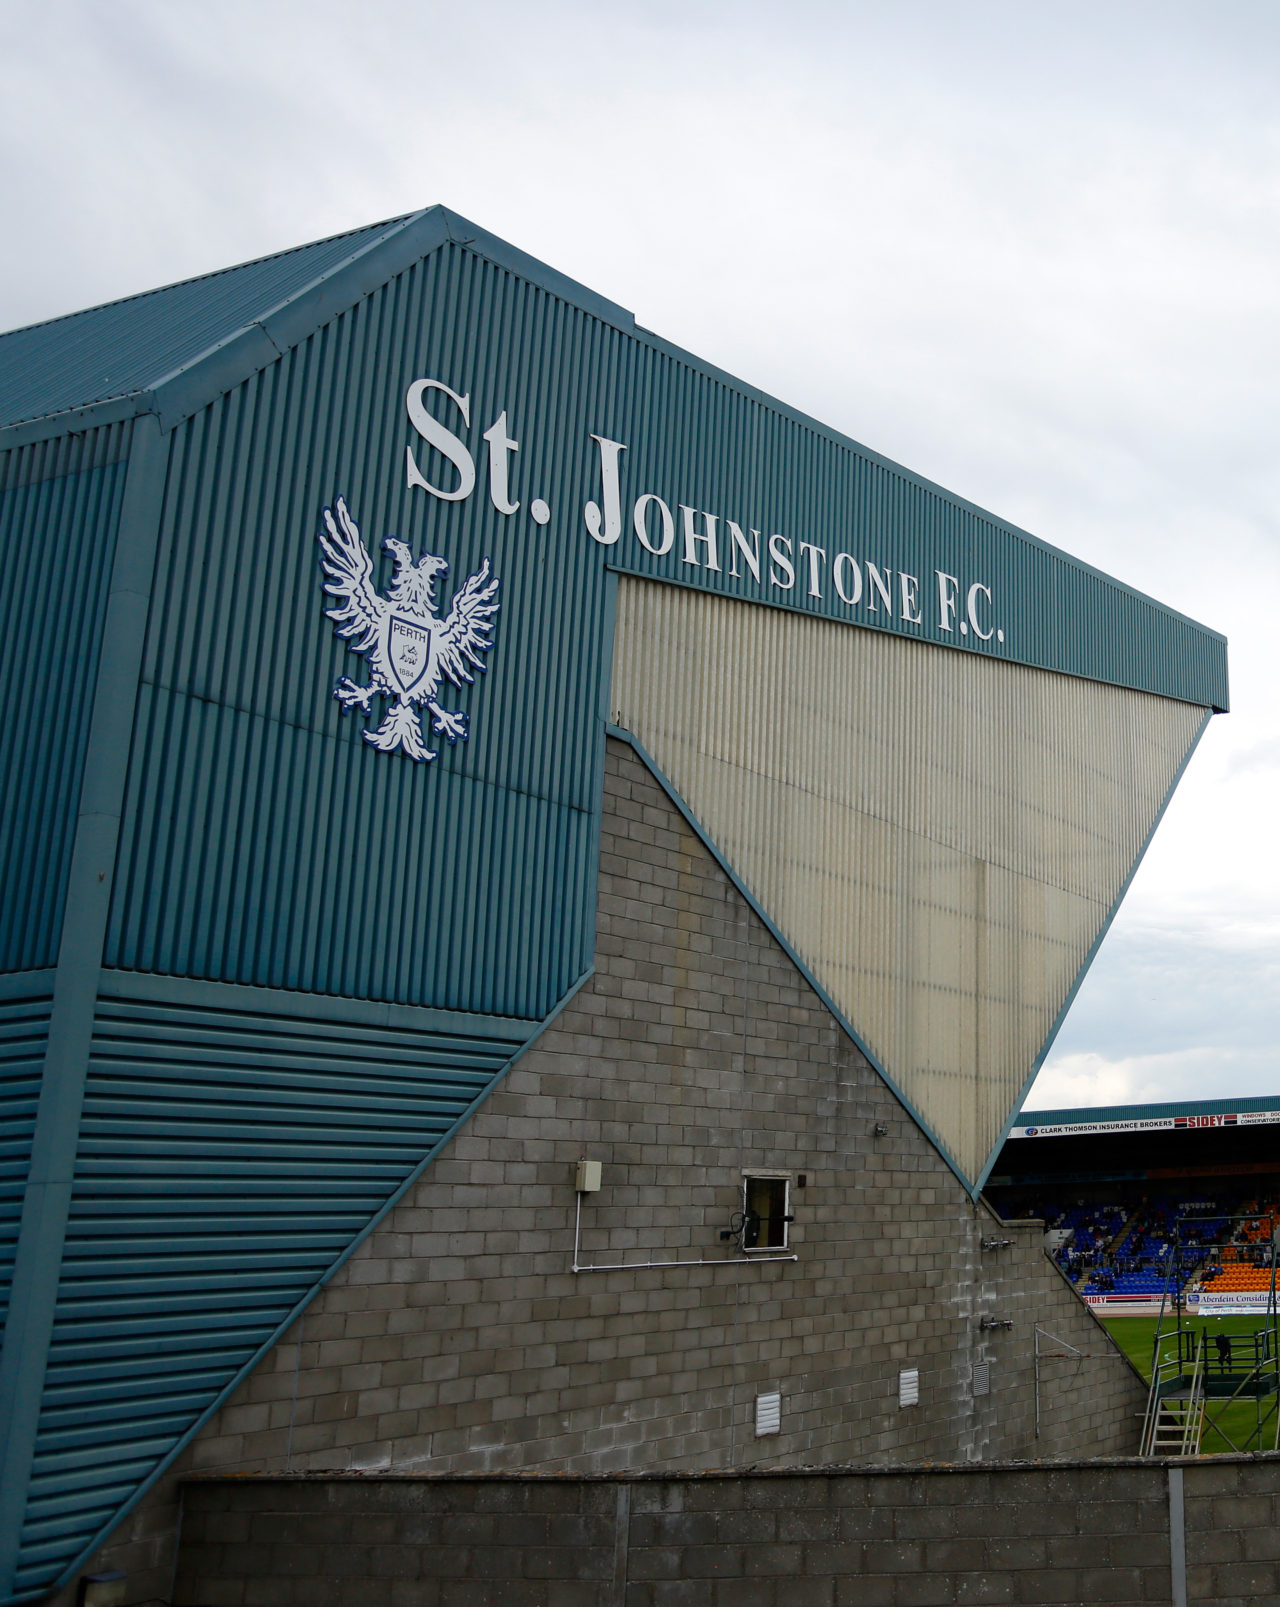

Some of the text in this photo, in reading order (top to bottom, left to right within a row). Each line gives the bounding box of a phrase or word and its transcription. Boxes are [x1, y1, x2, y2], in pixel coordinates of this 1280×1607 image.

[407, 378, 1005, 644] St. JOHNSTONE F.C.
[393, 623, 426, 643] PERTH
[399, 668, 414, 678] 1884
[1040, 1120, 1173, 1135] CLARK THOMSON INSURANCE BROKERS
[1188, 1114, 1224, 1128] SIDEY
[1083, 1296, 1106, 1304] SIDEY
